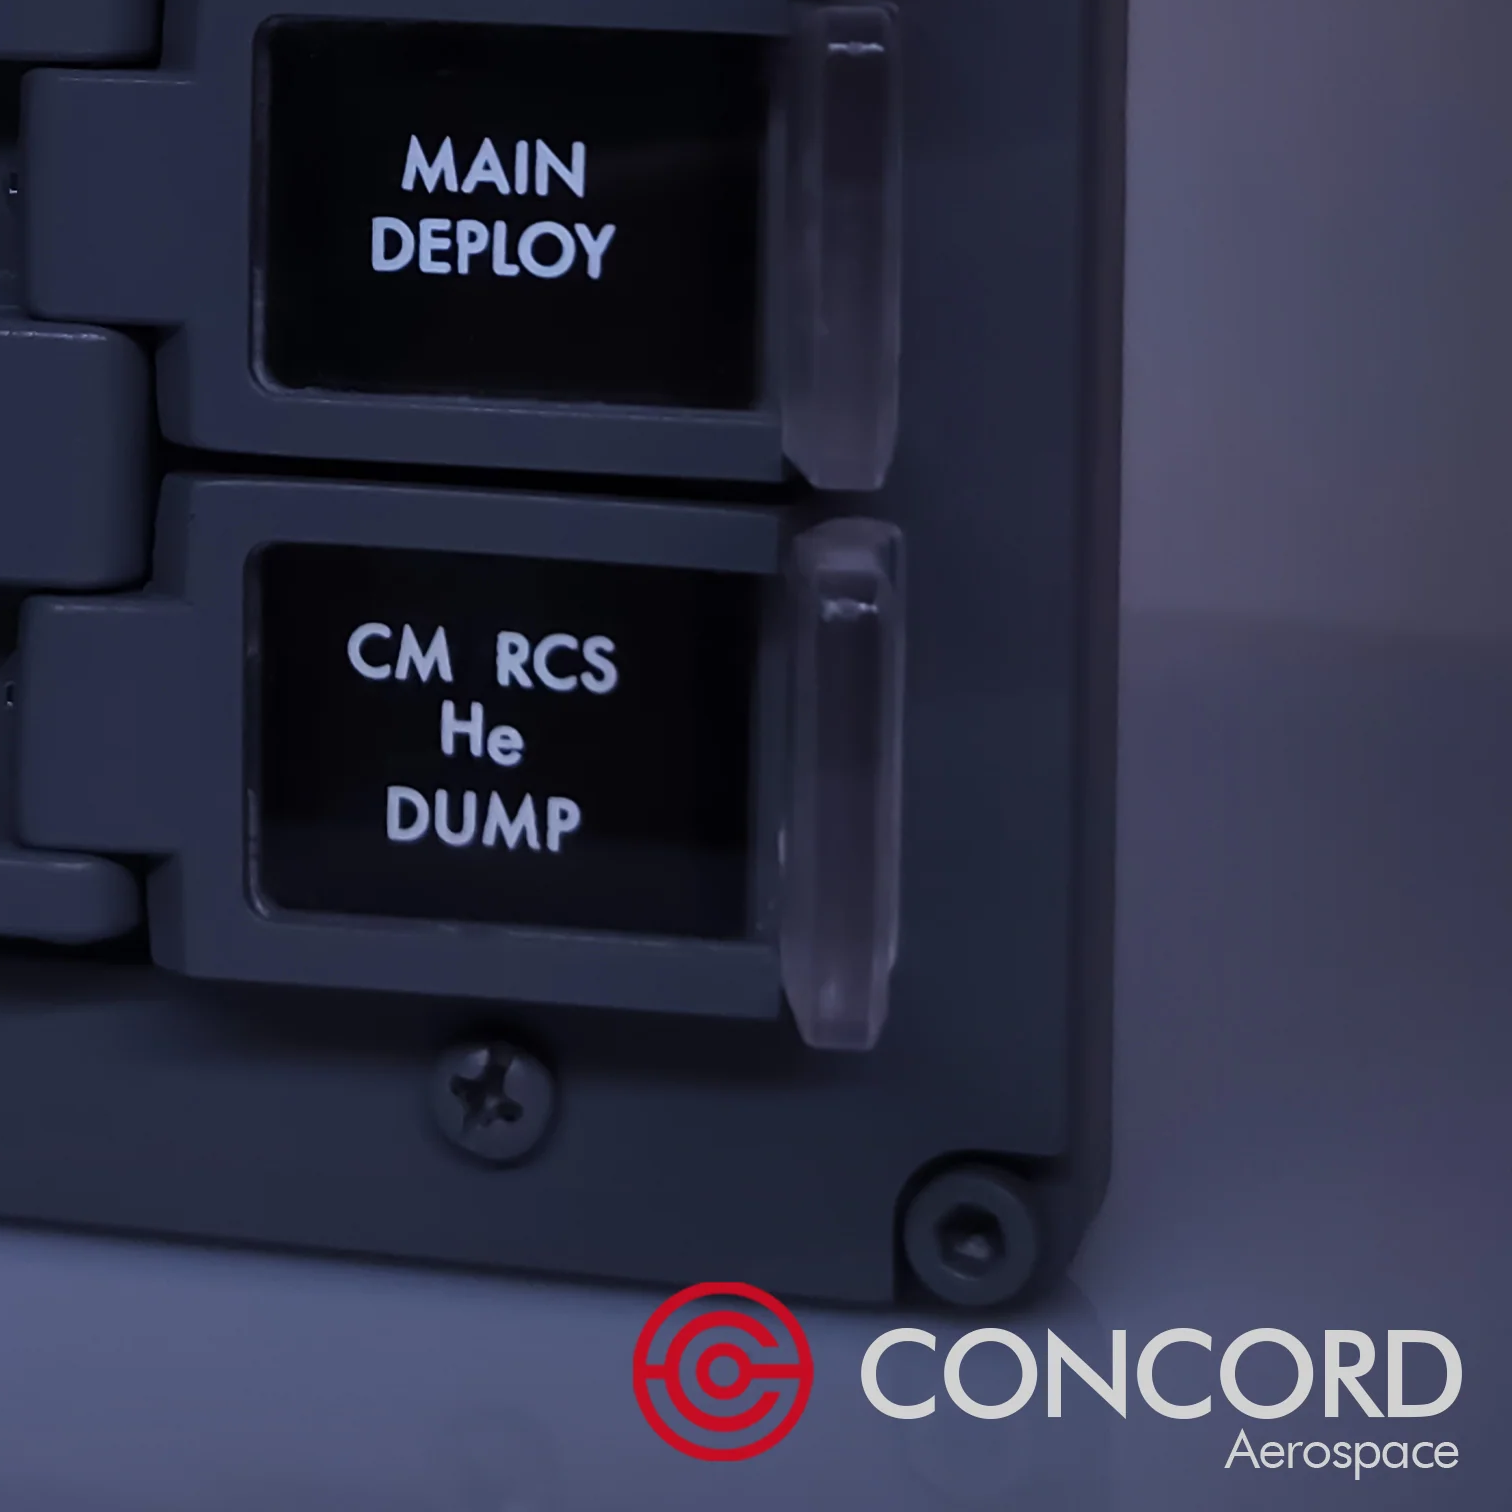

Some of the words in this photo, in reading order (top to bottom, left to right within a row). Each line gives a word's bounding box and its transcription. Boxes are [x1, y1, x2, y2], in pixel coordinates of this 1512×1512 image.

[401, 134, 586, 198] MAIN
[371, 216, 616, 279] DEPLOY
[347, 622, 453, 683] CM
[496, 631, 618, 694] RCS
[441, 699, 524, 766] He
[386, 785, 581, 852] DUMP
